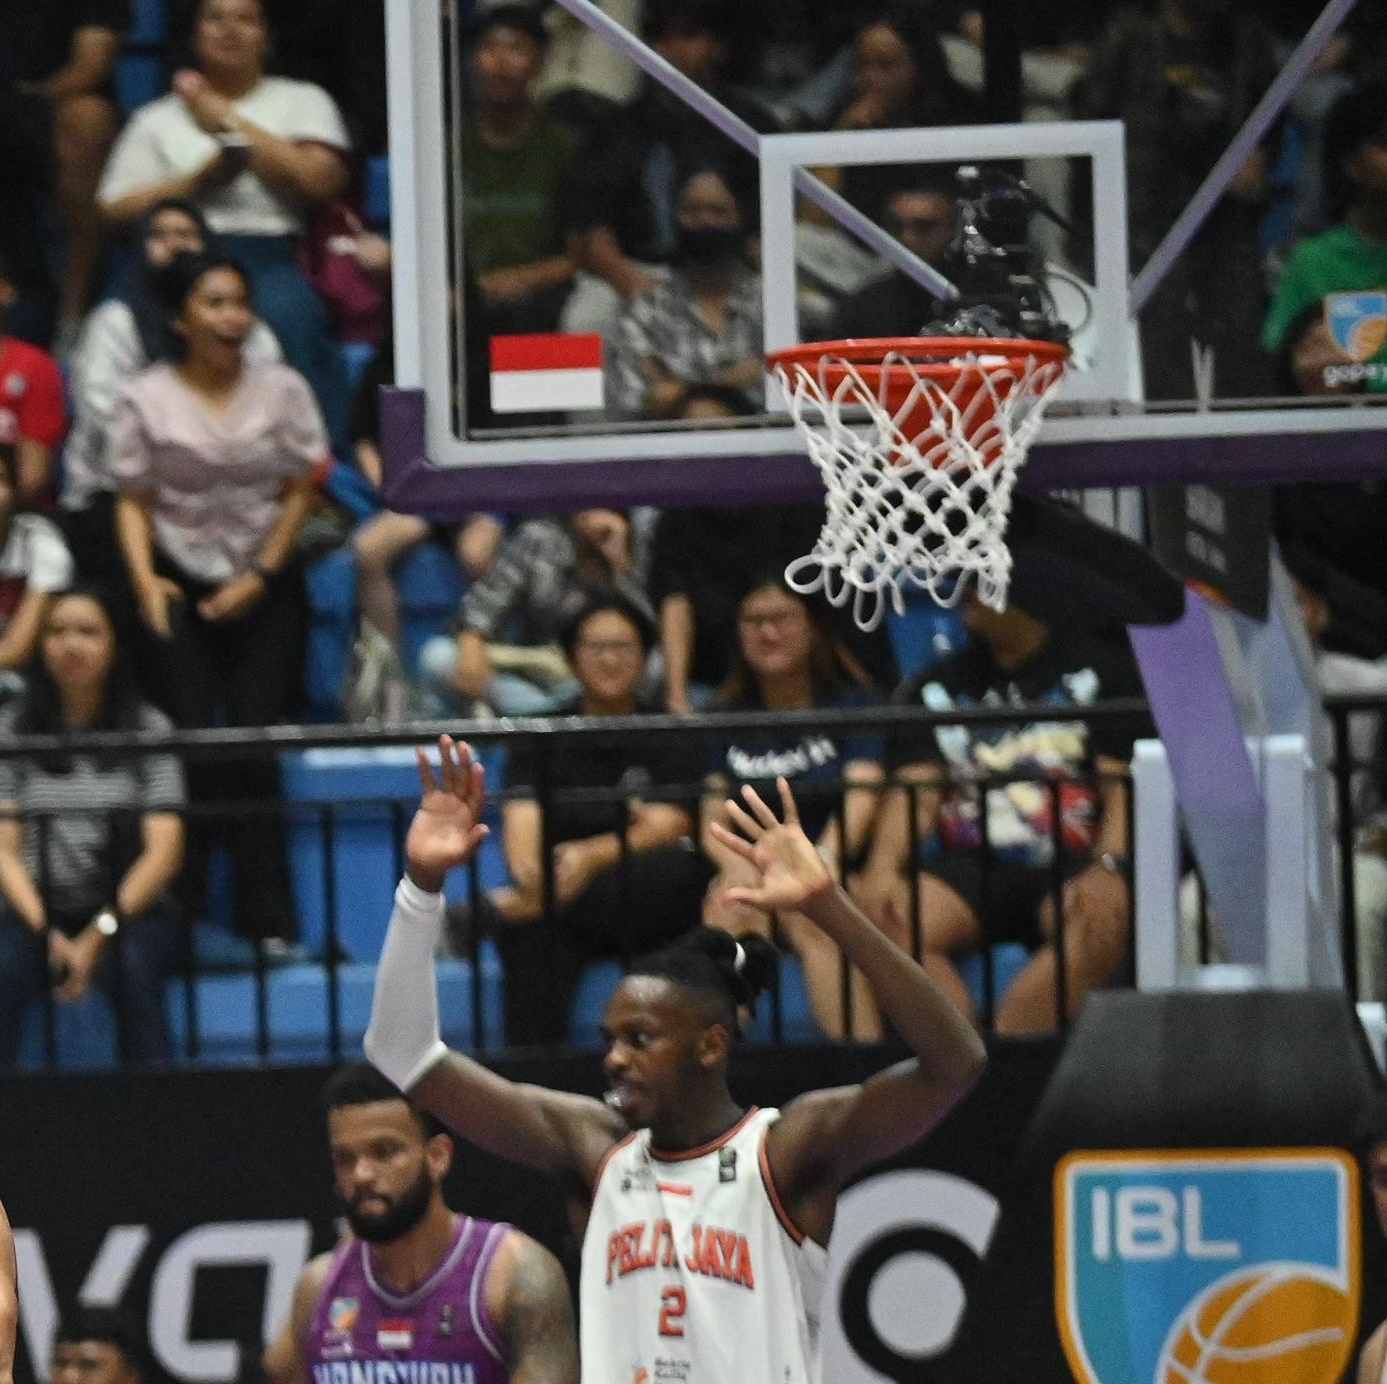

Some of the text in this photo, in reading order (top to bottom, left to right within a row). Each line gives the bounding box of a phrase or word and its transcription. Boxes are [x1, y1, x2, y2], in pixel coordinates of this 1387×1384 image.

[684, 1221, 756, 1291] JAYA
[1091, 1185, 1241, 1262] IBL
[658, 1285, 687, 1338] 2
